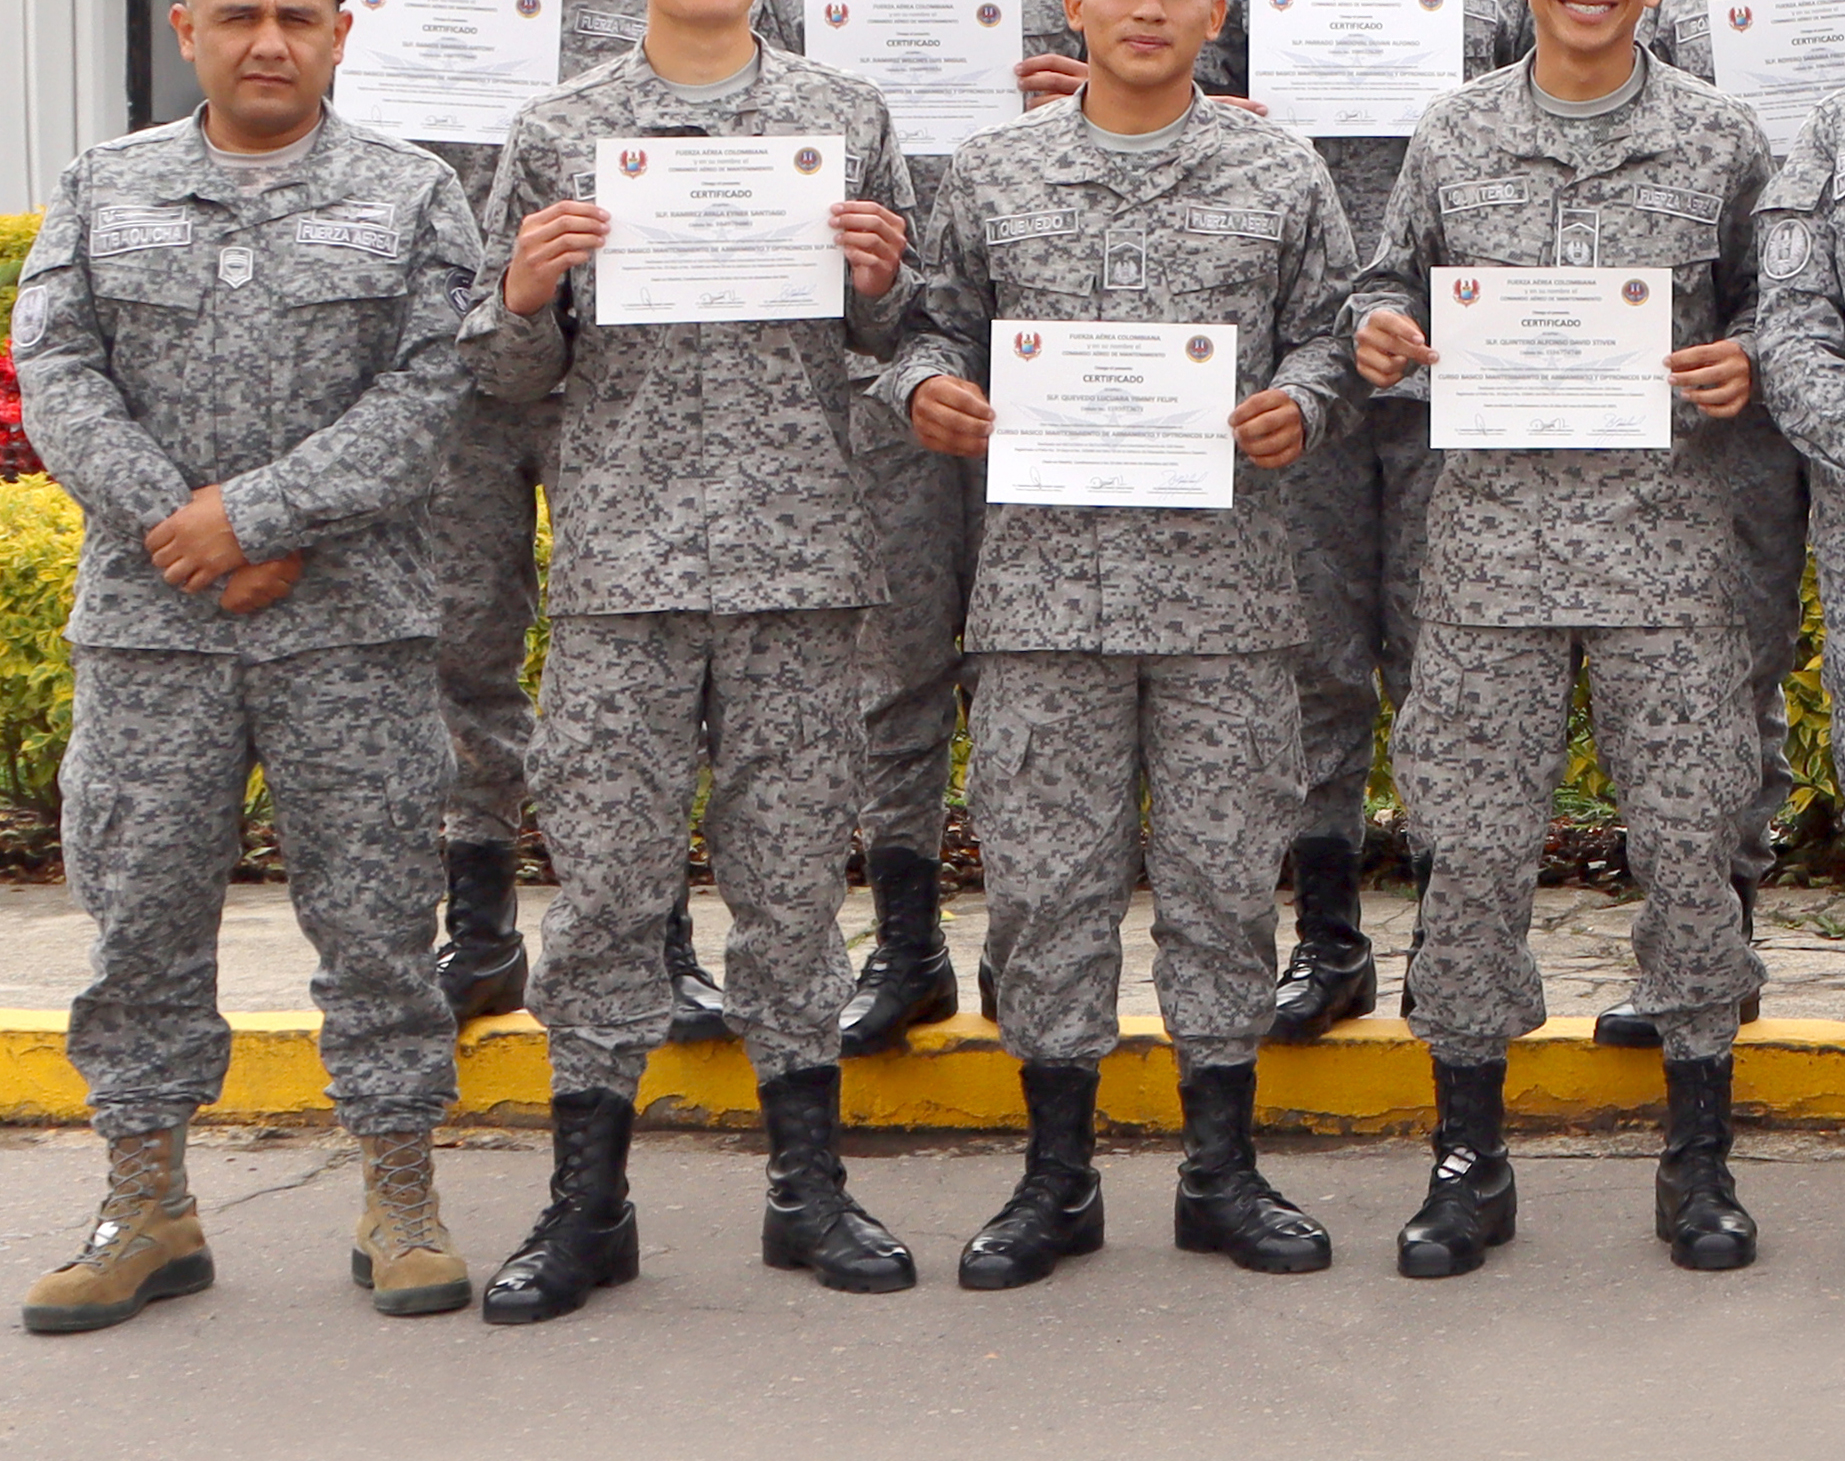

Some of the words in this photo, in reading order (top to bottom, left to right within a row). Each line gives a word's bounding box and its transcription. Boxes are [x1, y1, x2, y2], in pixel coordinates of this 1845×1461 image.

[580, 16, 618, 33] FUERZA
[1329, 22, 1383, 30] CERTIFICADO
[422, 24, 478, 35] CERTIFICADO
[886, 39, 940, 47] CERTIFICADO
[1791, 34, 1844, 46] CERTIFICADO
[701, 148, 723, 156] AÉREA
[690, 190, 752, 199] CERTIFICADO
[1451, 184, 1514, 206] QUINTERO
[1640, 189, 1681, 209] FUERZA
[750, 209, 786, 217] SANTIAGO
[1001, 216, 1063, 236] QUEVEDO
[1192, 214, 1233, 229] FUERZA
[301, 225, 350, 242] FUERZA
[351, 229, 391, 250] AEREA
[1532, 278, 1553, 286] AÉREA
[1521, 319, 1581, 328] CERTIFICADO
[1095, 333, 1117, 341] AÉREA
[1083, 374, 1144, 384] CERTIFICADO
[1061, 394, 1095, 402] QUEVEDO
[1156, 395, 1178, 403] FELIPE
